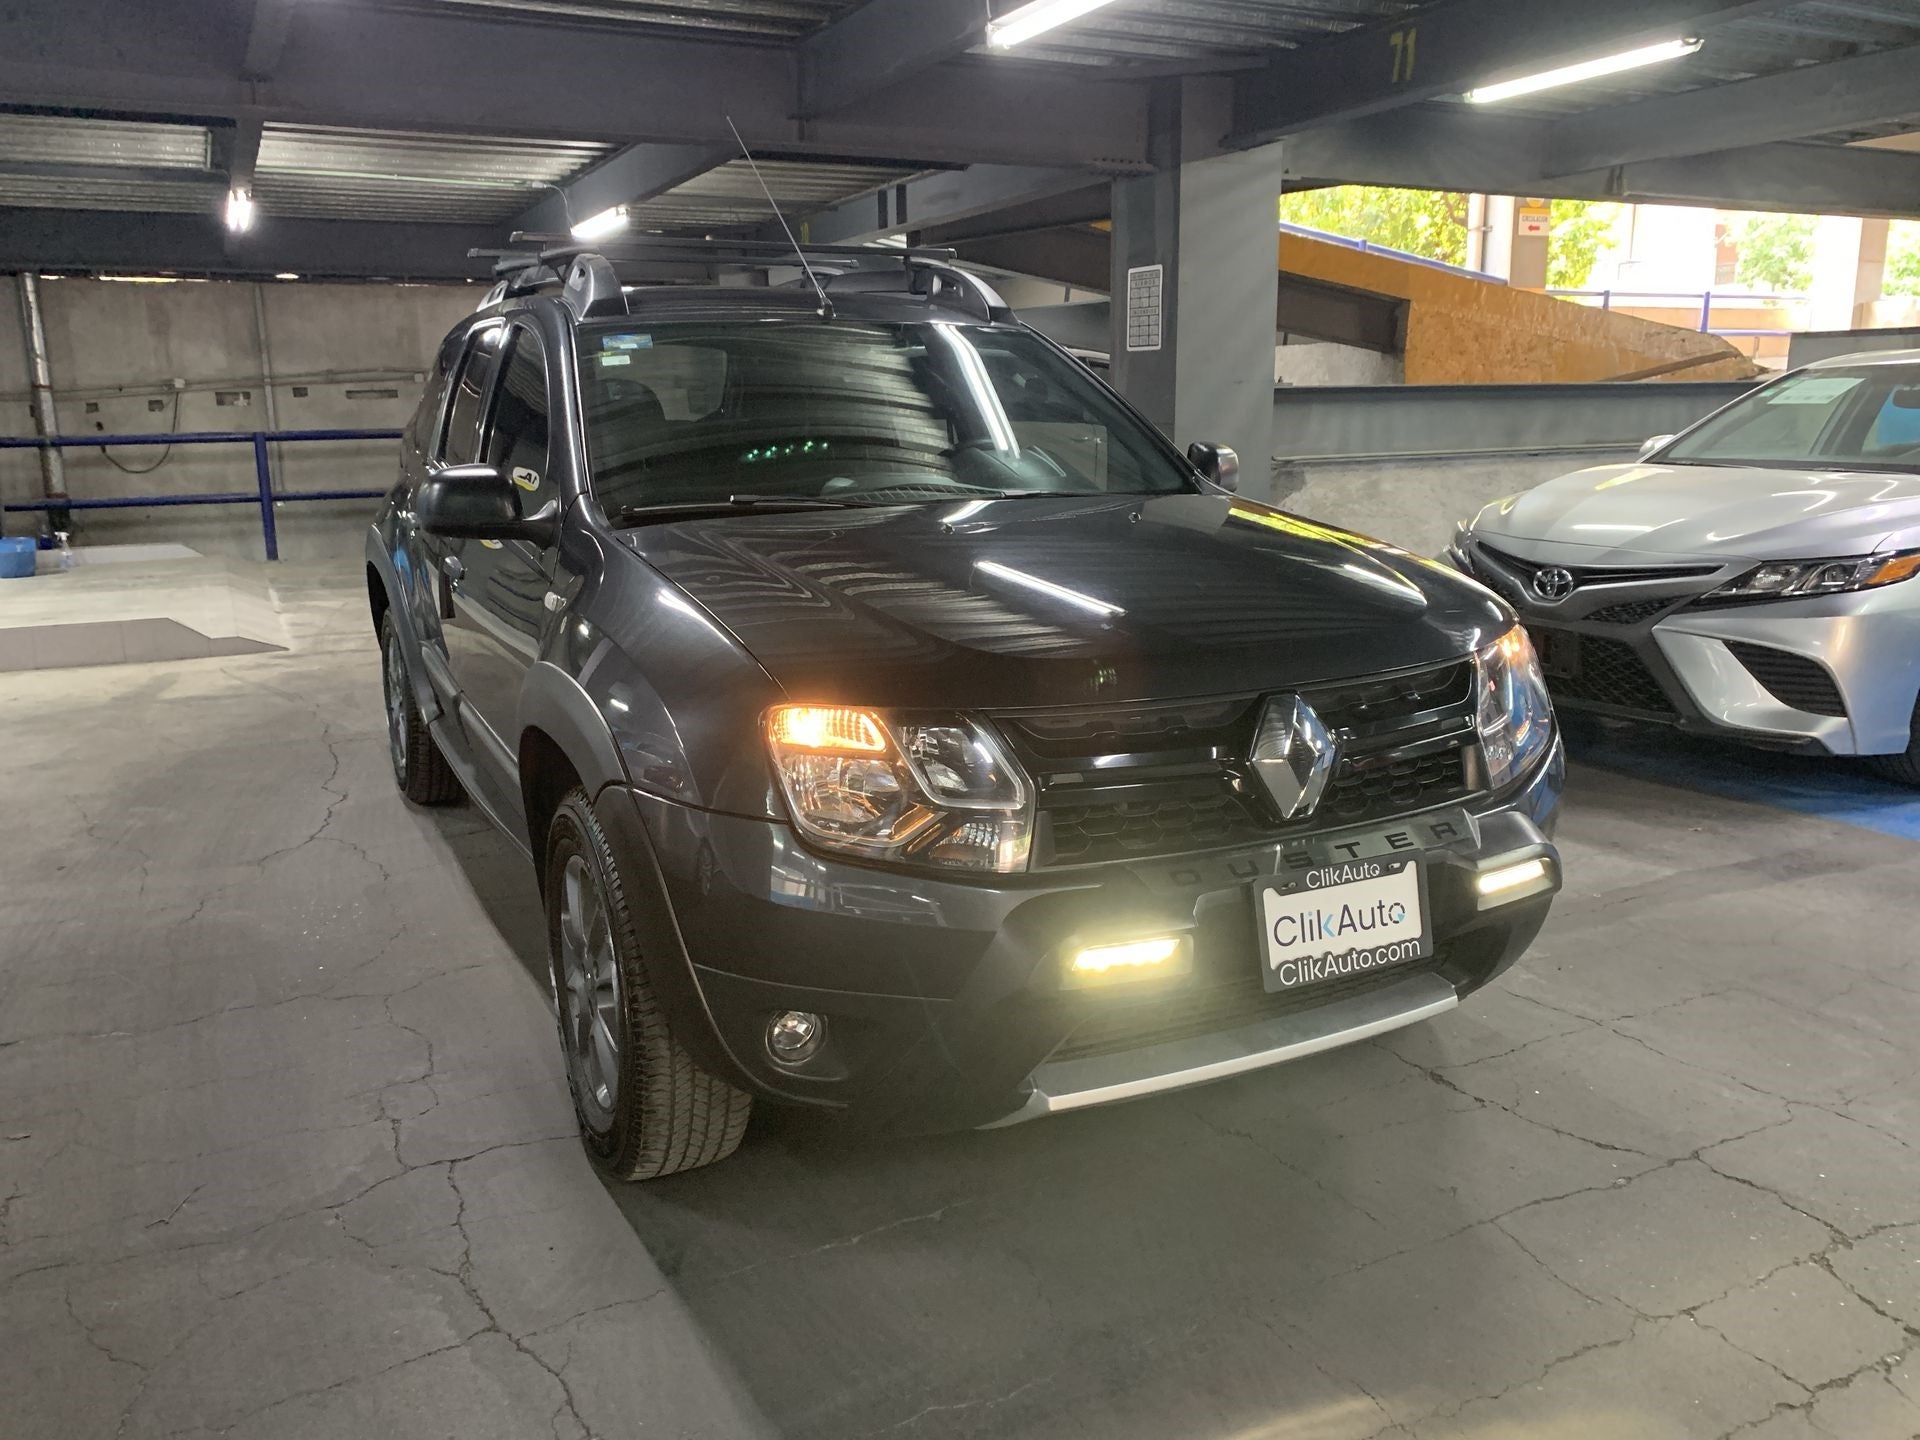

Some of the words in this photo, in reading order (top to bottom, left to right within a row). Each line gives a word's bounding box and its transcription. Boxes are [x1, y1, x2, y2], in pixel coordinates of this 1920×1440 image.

[1306, 861, 1380, 889] ClikAuto
[1273, 899, 1406, 947] ClikAuto
[1279, 939, 1421, 986] ClikAuto.com
